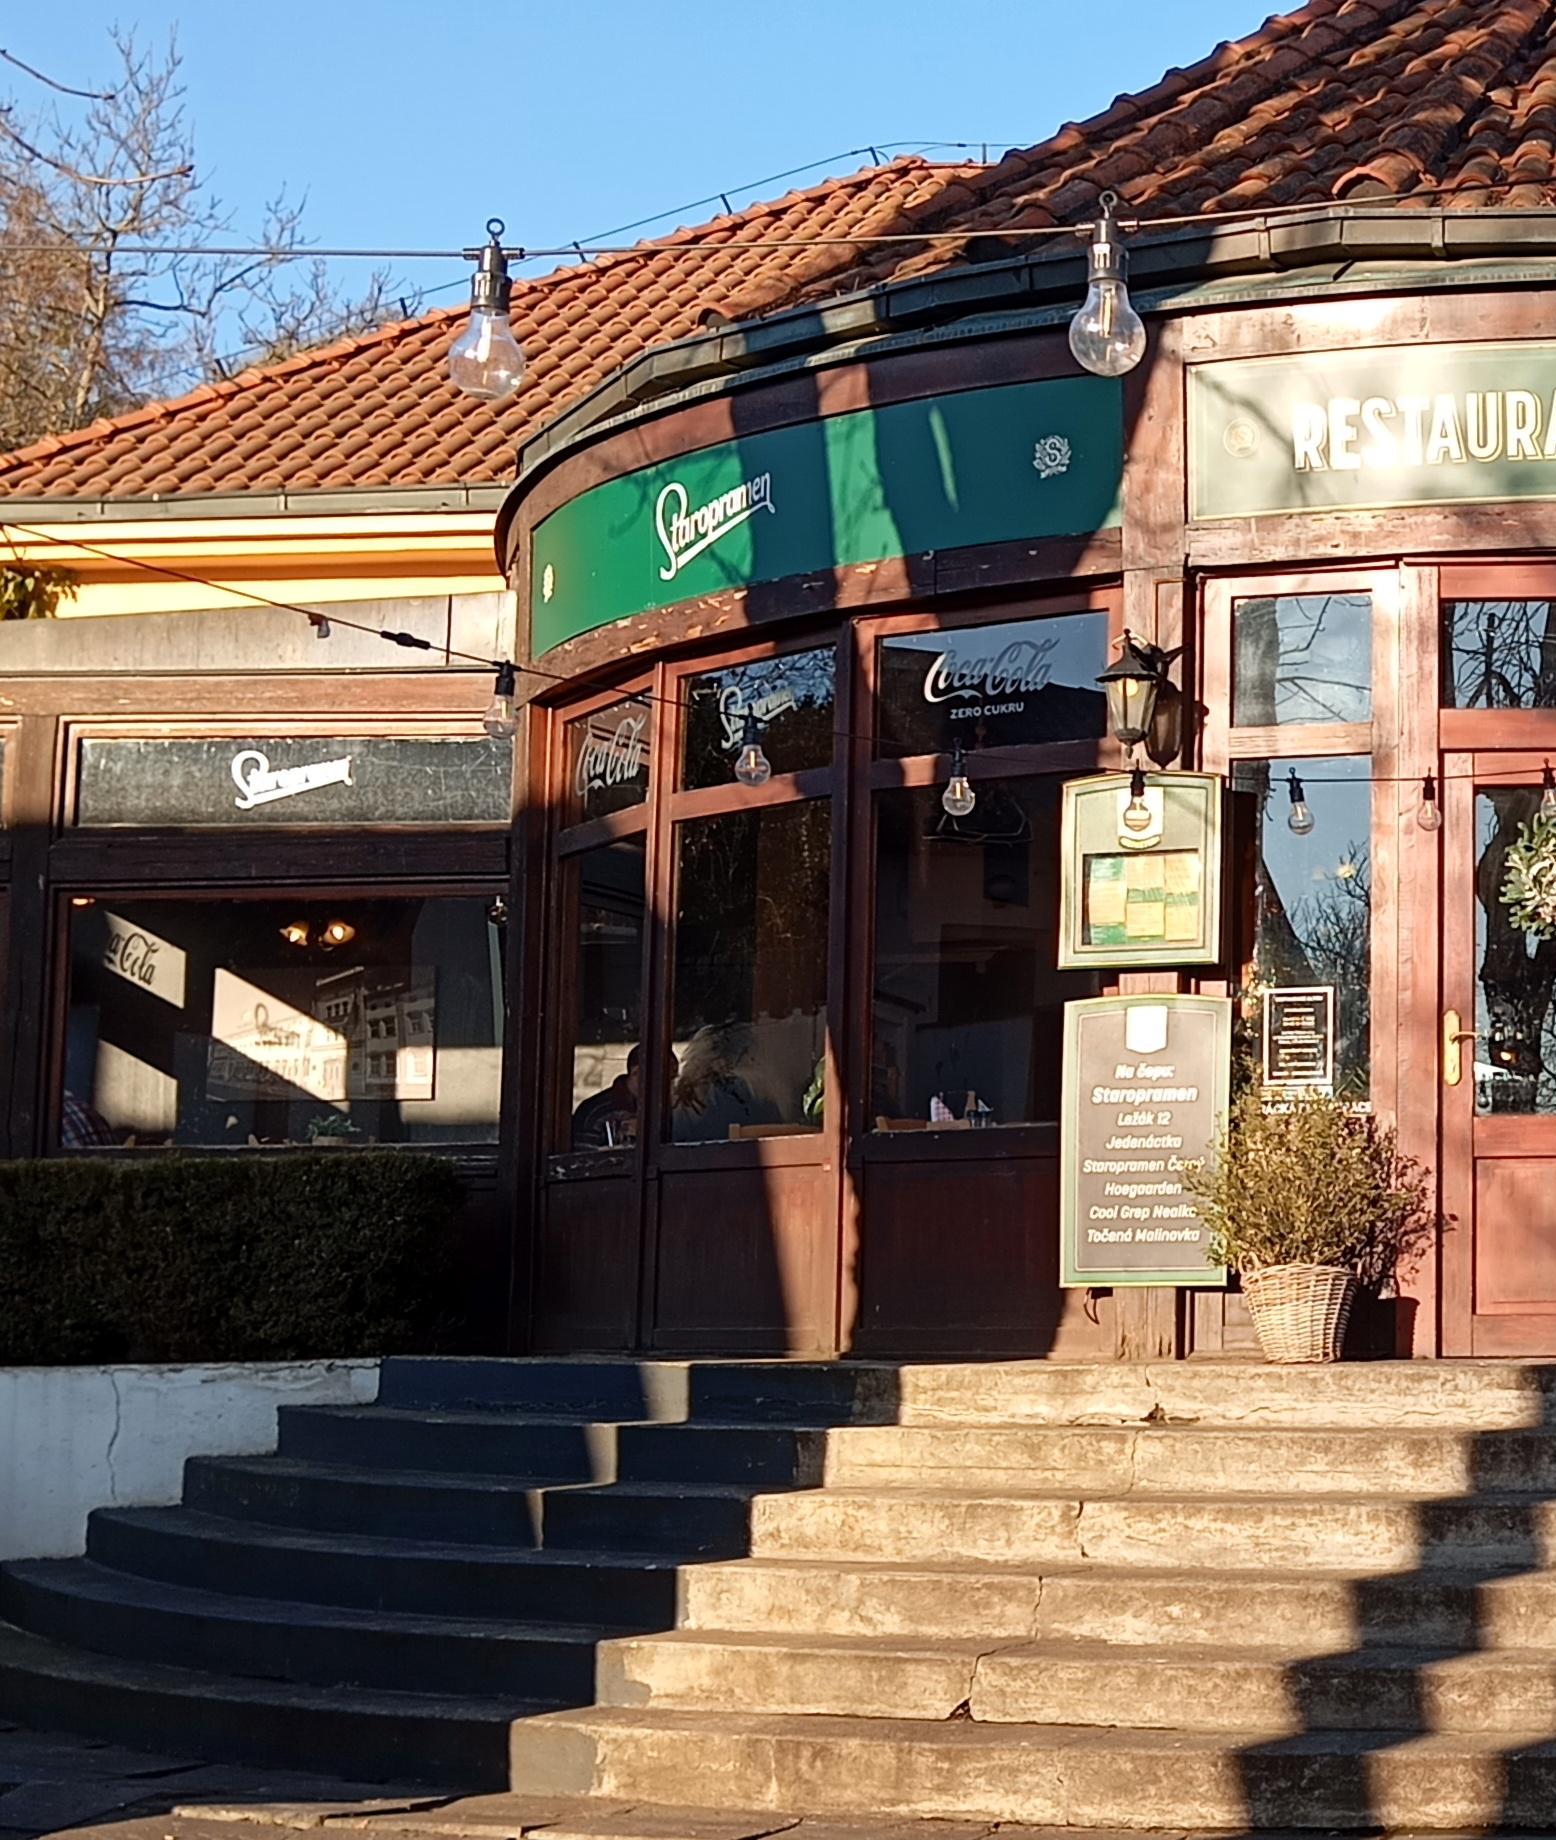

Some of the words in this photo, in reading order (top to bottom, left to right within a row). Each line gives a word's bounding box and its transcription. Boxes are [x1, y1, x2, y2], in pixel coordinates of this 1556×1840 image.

[656, 472, 775, 580] Staropramen
[924, 638, 1060, 702] Coca-Cola
[950, 707, 982, 719] ZERO
[984, 702, 1024, 716] CUKRU
[1091, 1086, 1199, 1106] Staropramen
[1117, 1110, 1154, 1127] Ležák
[1156, 1111, 1172, 1126] 12
[1105, 1134, 1182, 1150] Jedenáctka
[1083, 1159, 1165, 1174] Staropramen
[1105, 1181, 1182, 1198] Hoegaarden
[1089, 1205, 1118, 1219] Cool
[1120, 1205, 1150, 1221] Grep
[1087, 1228, 1132, 1242] Točená
[1135, 1228, 1201, 1242] Malinovka
